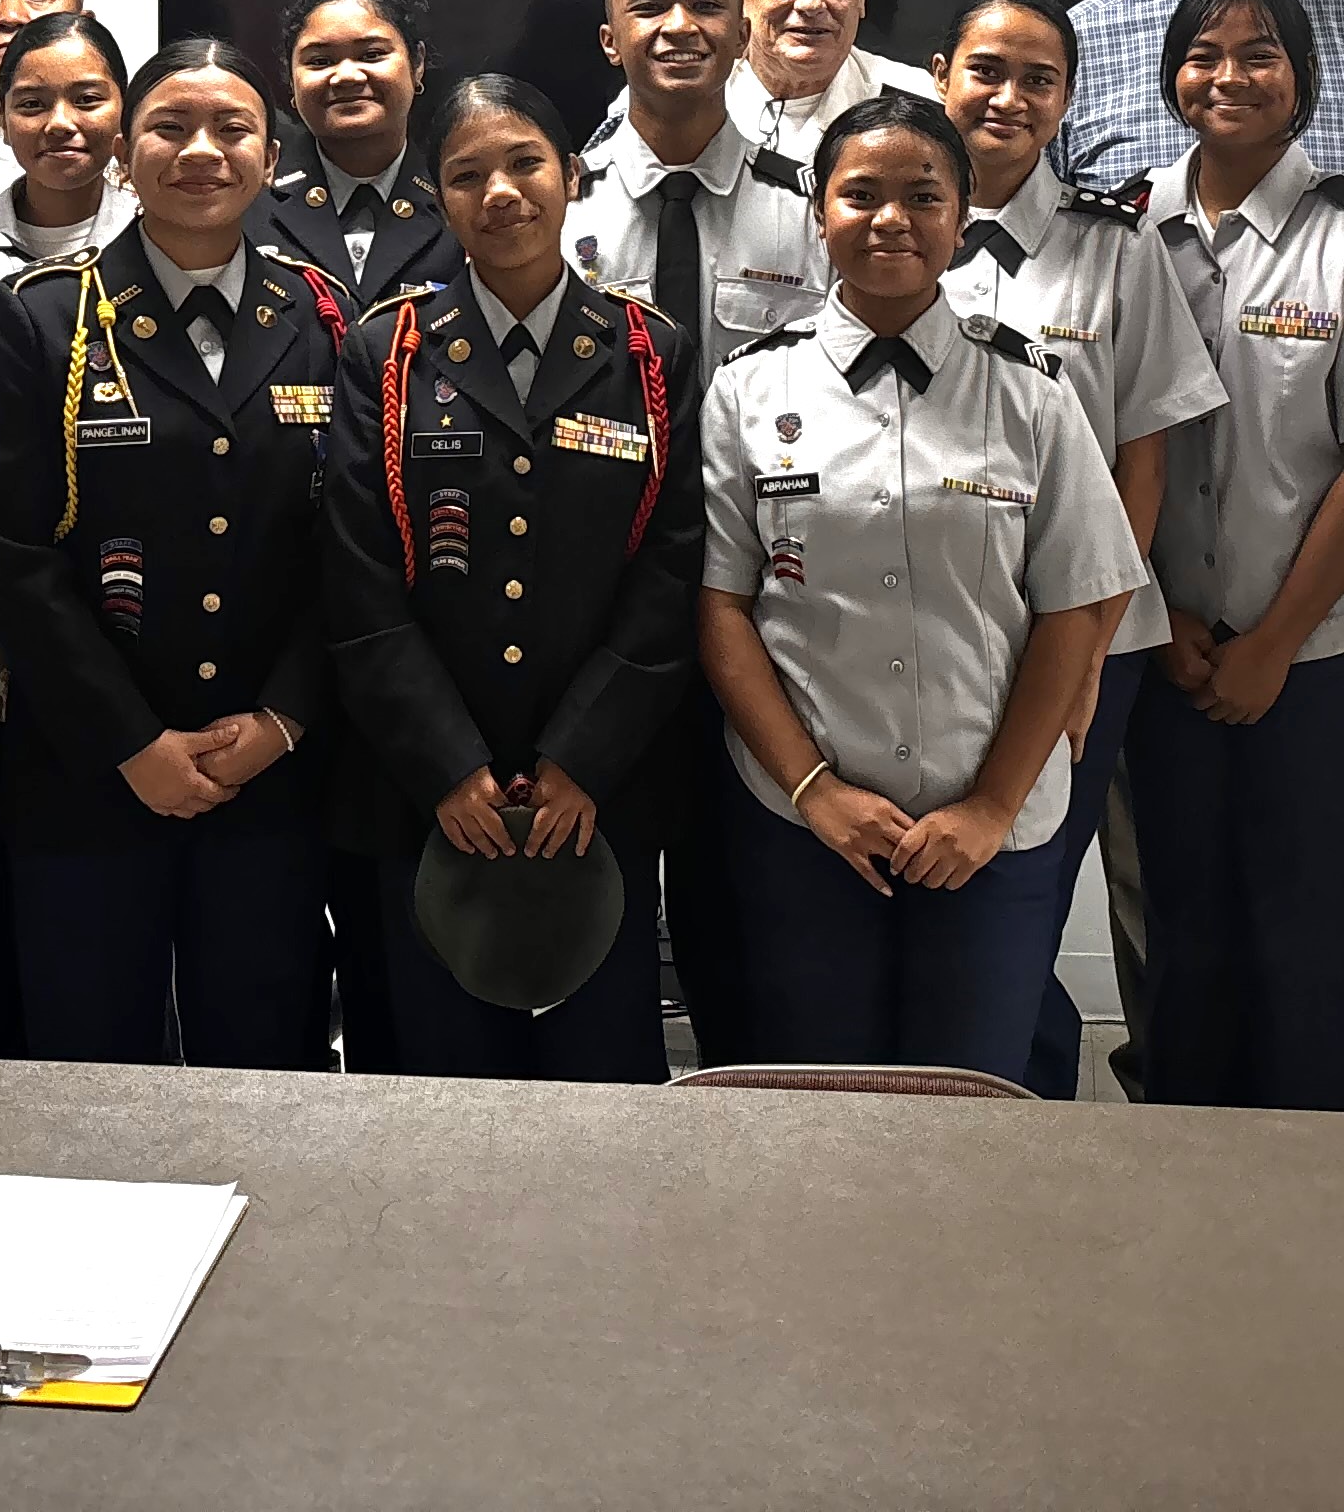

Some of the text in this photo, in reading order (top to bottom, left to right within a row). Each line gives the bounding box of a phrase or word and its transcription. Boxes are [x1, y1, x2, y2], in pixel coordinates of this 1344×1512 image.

[81, 425, 146, 439] PANGELINAN
[431, 439, 462, 450] CELIS
[762, 477, 810, 493] ABRAHAM
